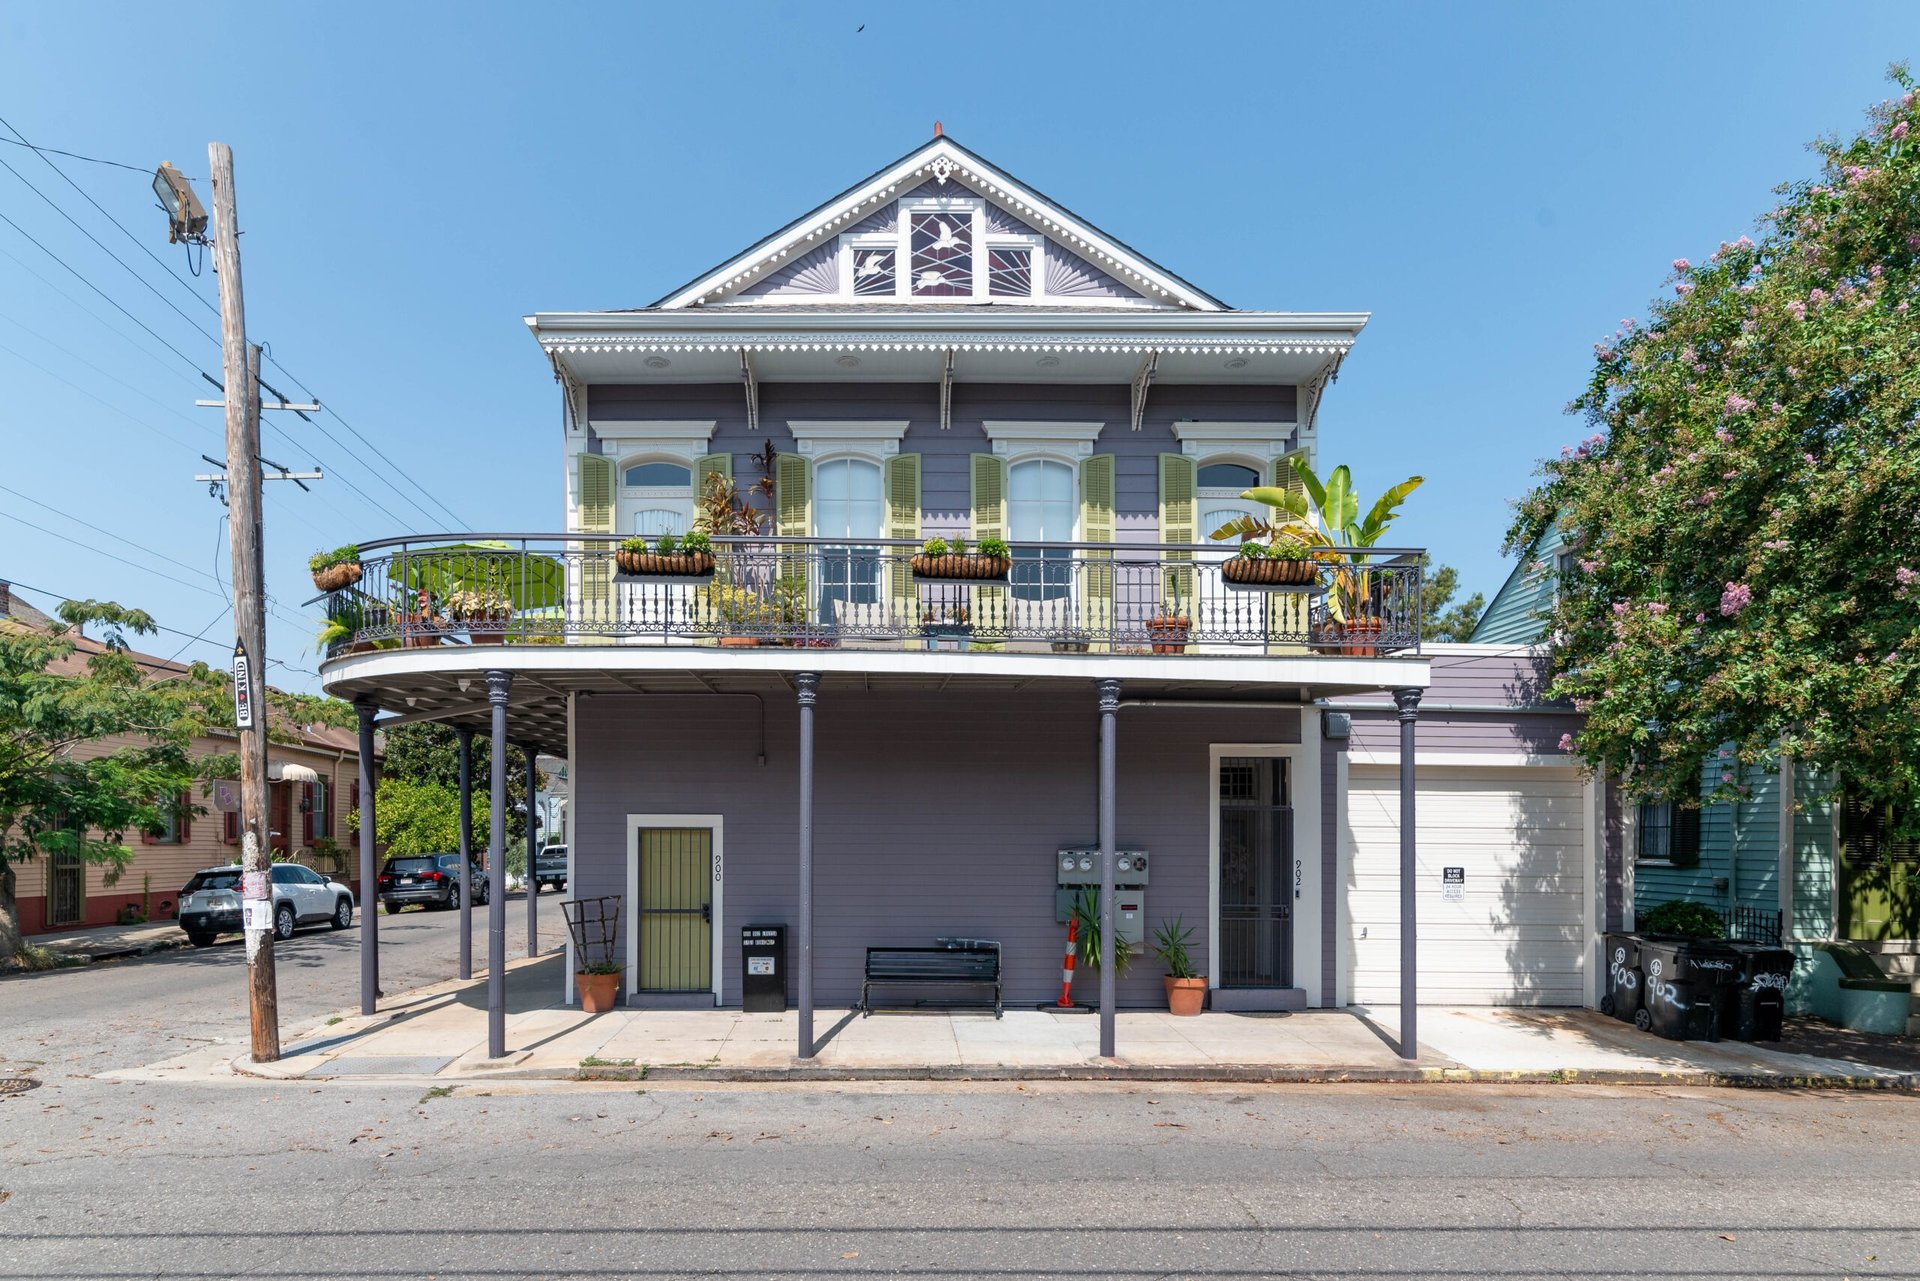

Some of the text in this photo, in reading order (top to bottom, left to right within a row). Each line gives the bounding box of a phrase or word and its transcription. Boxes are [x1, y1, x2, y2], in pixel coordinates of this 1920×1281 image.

[237, 663, 248, 718] BE KIND
[1611, 962, 1636, 993] 900
[1647, 976, 1687, 1010] 902
